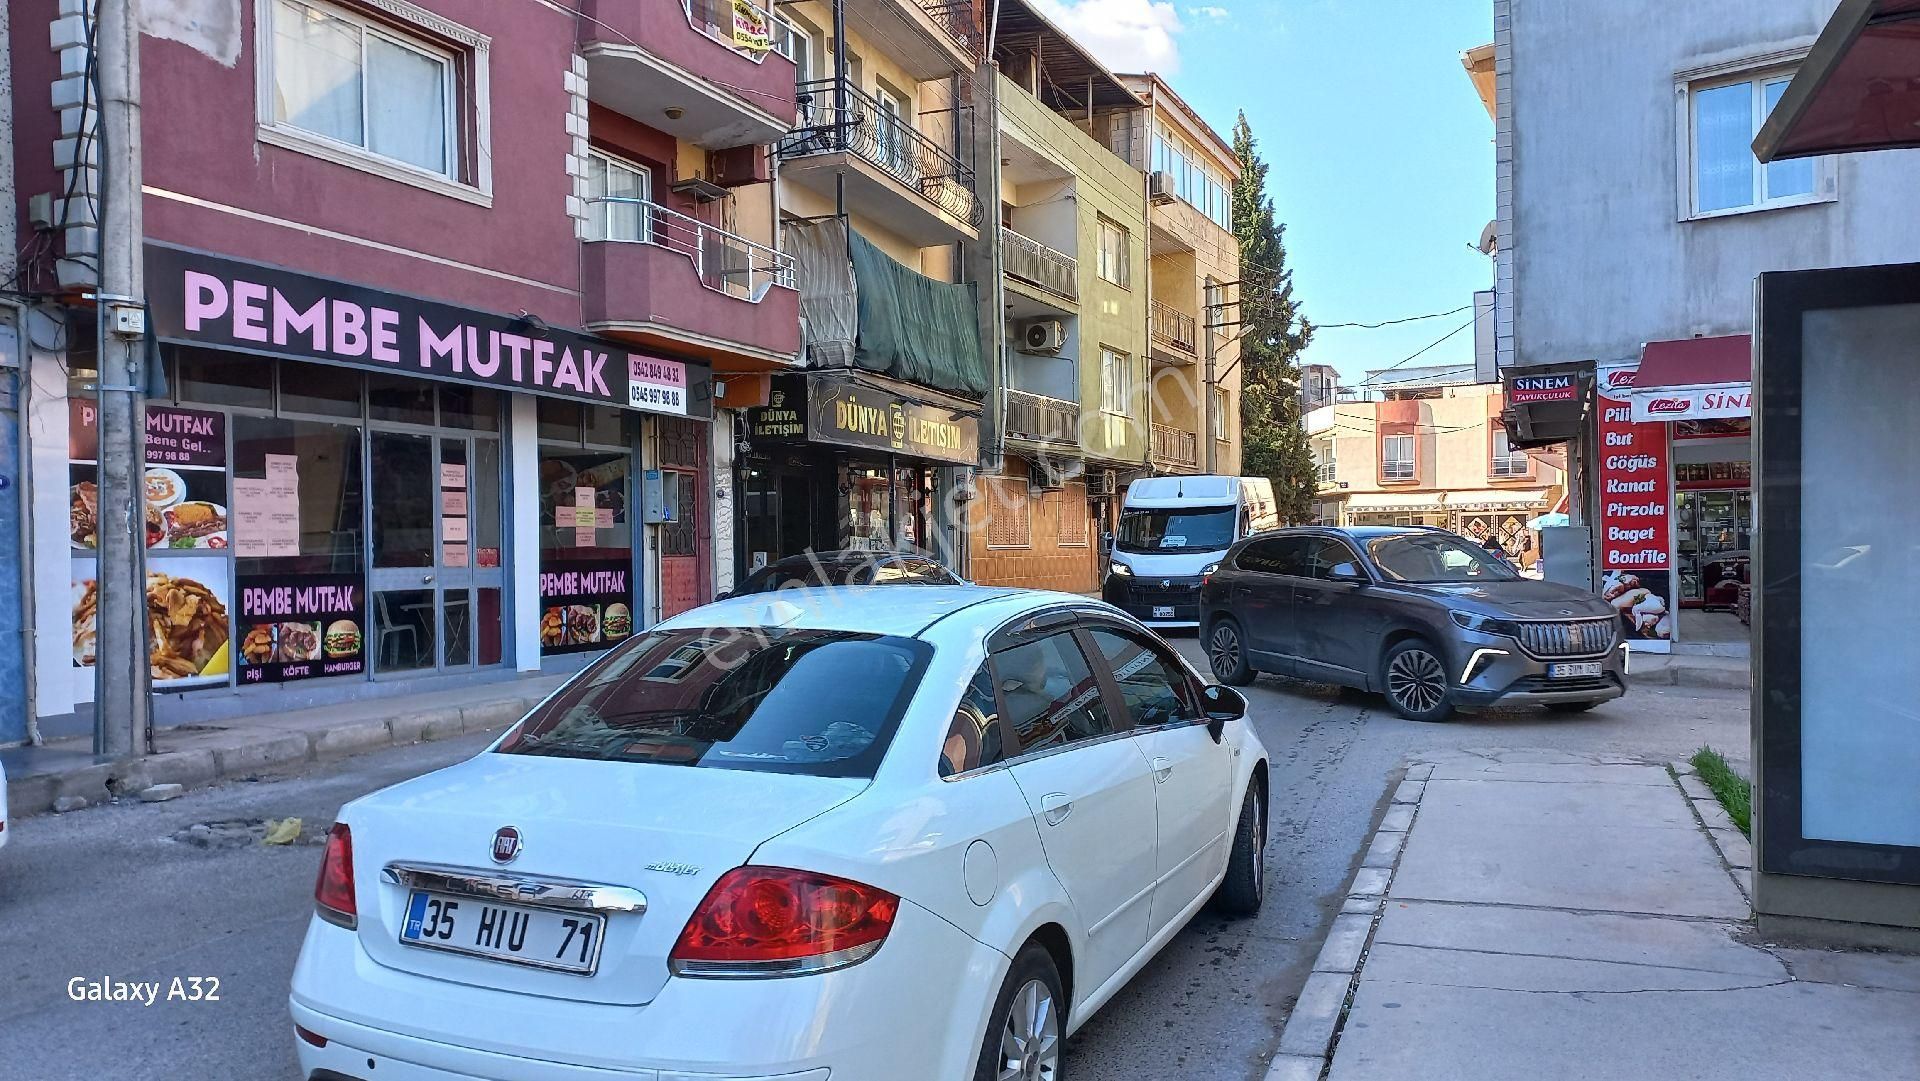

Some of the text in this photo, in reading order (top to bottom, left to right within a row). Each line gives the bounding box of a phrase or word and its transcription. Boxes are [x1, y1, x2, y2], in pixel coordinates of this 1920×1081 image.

[185, 270, 611, 397] PEMBE MUTFAK
[633, 361, 648, 378] 0542
[649, 364, 662, 379] 849
[1516, 376, 1570, 390] SİNEM
[649, 388, 661, 404] 997
[1515, 391, 1572, 401] TAVUKÇULUK
[1650, 397, 1689, 411] Lezita
[760, 407, 797, 422] DÜNYA
[147, 413, 213, 436] MUTFAK
[754, 423, 804, 437] İLETİŞİM
[836, 396, 961, 453] DÜNYA İLETİŞİM
[1605, 431, 1634, 446] But
[146, 450, 190, 461] 997 98 88
[1606, 454, 1657, 472] Göğüs
[1606, 478, 1656, 493] Kanat
[1607, 501, 1665, 517] Pirzola
[1608, 526, 1656, 544] Baget
[1608, 549, 1667, 564] Bonfile
[540, 570, 625, 597] PEMBE MUTFAK
[243, 585, 354, 616] PEMBE MUTFAK
[282, 665, 310, 677] KÖFTE
[324, 661, 361, 673] HAMBURGER
[495, 836, 517, 855] FIAT
[409, 919, 422, 931] TR
[422, 900, 593, 962] 35 HIU 71
